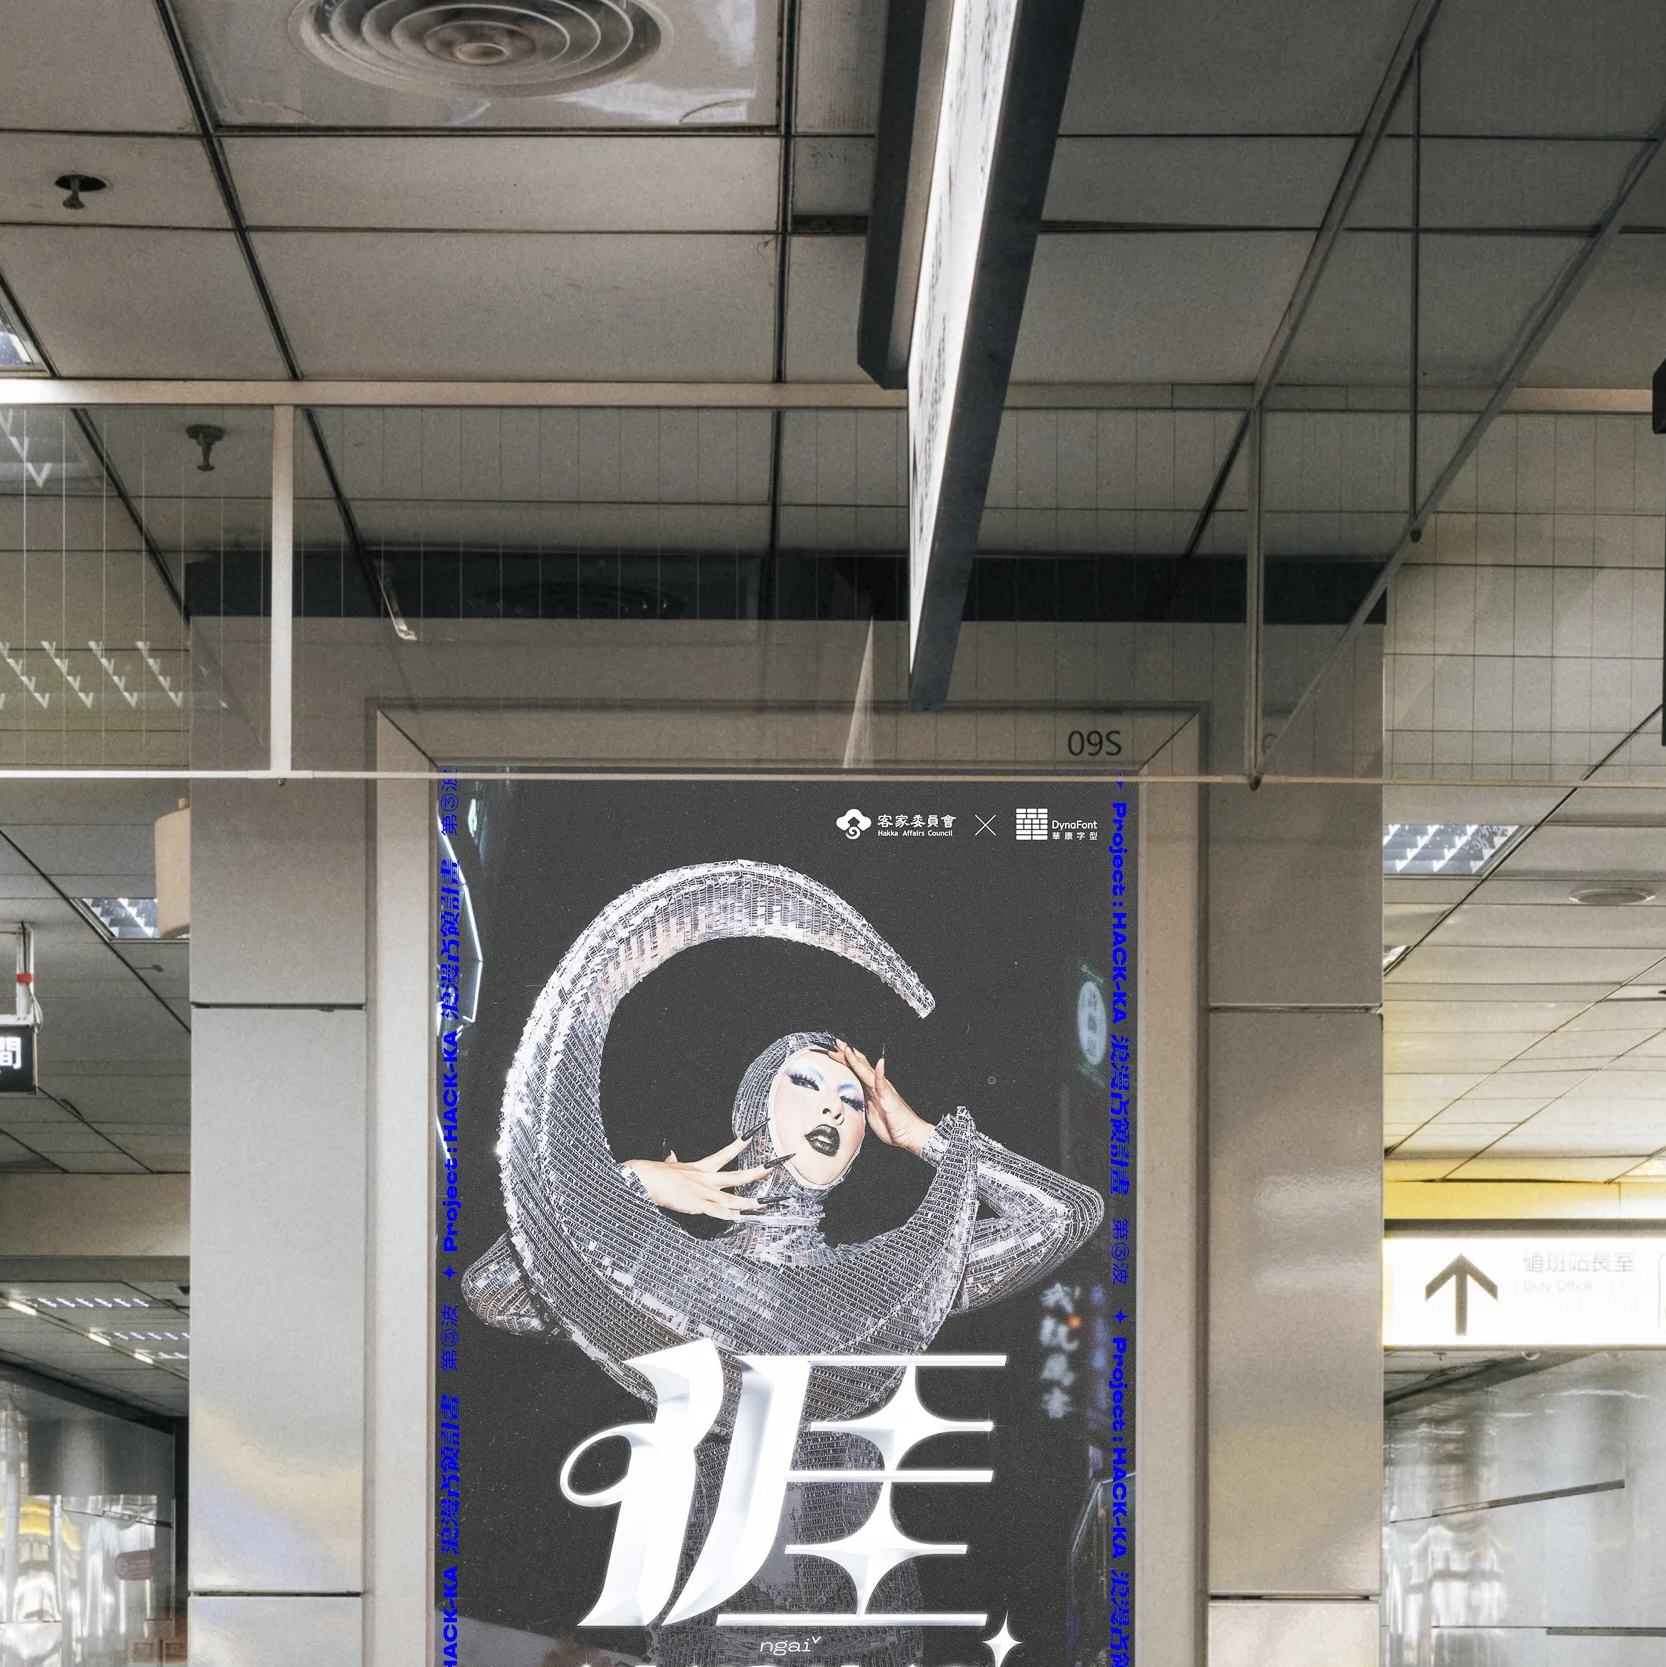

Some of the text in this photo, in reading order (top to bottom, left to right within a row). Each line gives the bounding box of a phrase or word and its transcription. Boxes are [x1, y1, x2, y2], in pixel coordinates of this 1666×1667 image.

[1066, 729, 1123, 757] 09S
[876, 813, 957, 829] 客家委員會
[1051, 819, 1098, 832] DynaFont
[877, 829, 953, 837] Hakka Affairs Council
[1052, 831, 1098, 841] 華康字型
